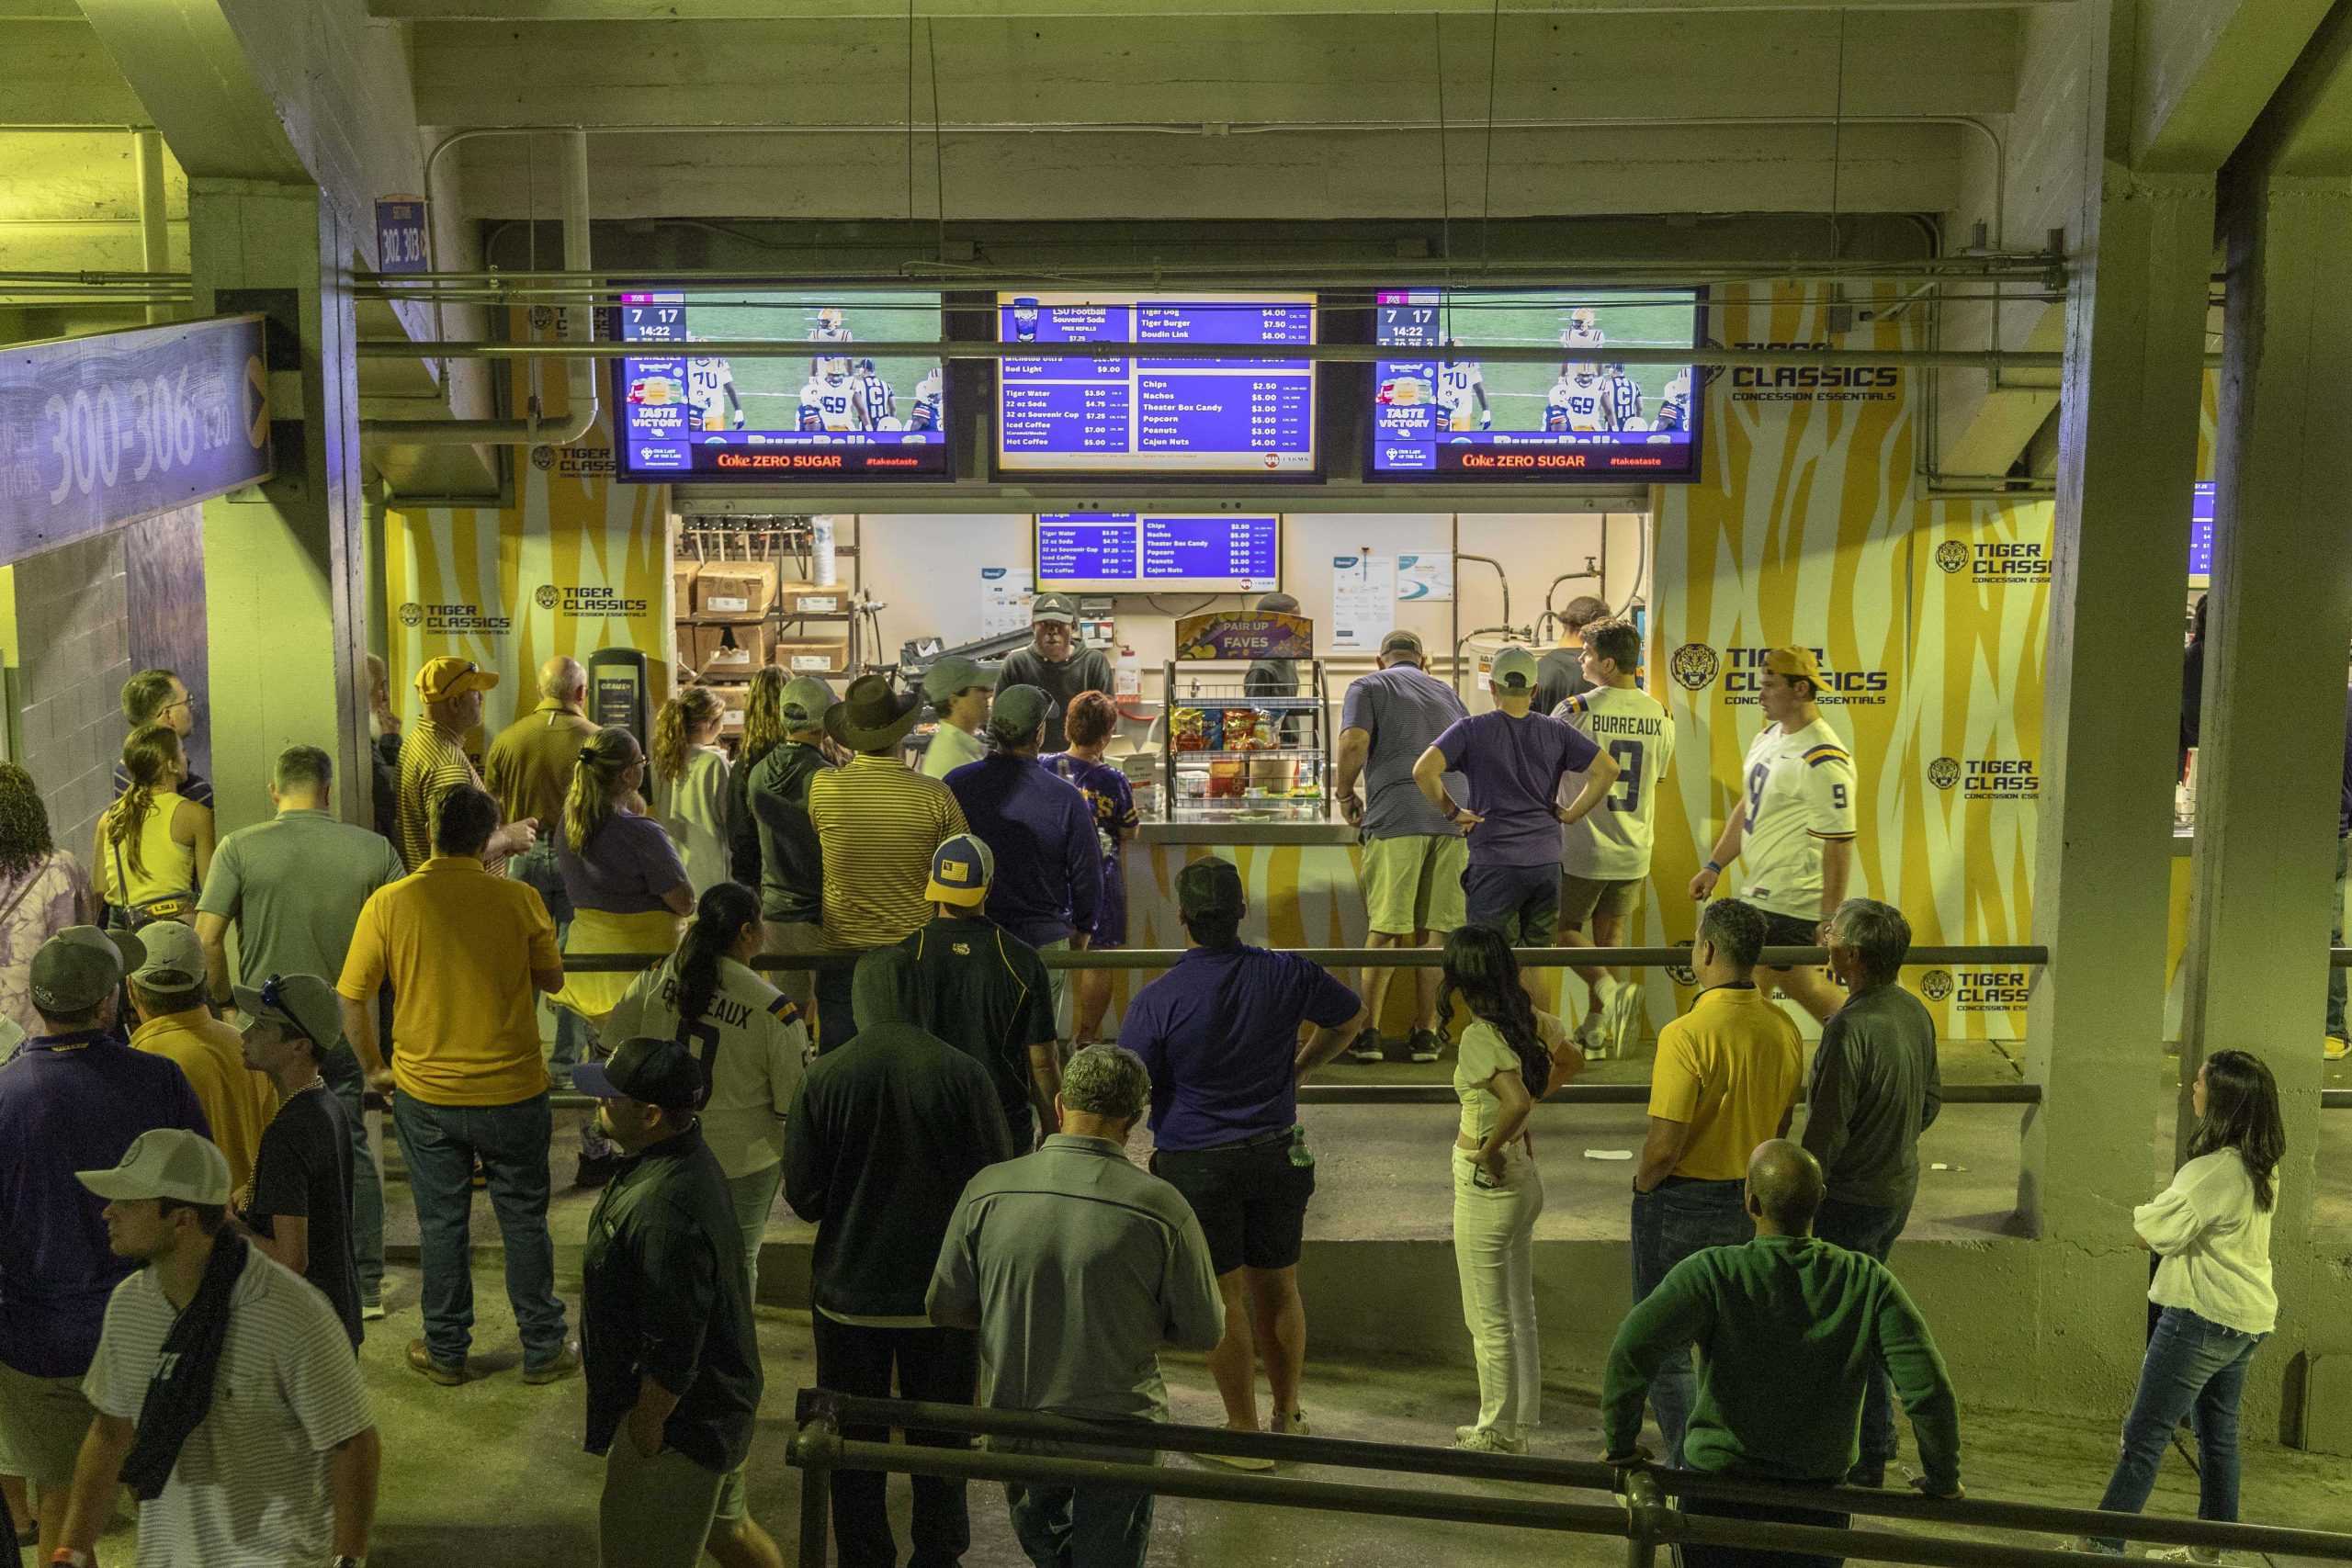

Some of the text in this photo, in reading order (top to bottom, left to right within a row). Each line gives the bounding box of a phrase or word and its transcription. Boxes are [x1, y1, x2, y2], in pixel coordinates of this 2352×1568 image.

[382, 227, 419, 265] 302 303
[632, 309, 678, 323] 7 17
[1143, 309, 1286, 317] Tiger Dog $4.00
[1386, 310, 1431, 323] 7 17
[1163, 320, 1191, 328] Burger
[1263, 321, 1286, 329] $7.50
[639, 326, 671, 336] 14:22
[1393, 327, 1423, 336] 14:22
[1023, 366, 1042, 374] Light
[1733, 367, 1897, 387] CLASSICS
[1143, 380, 1277, 390] Chips $2.50
[1006, 389, 1025, 399] Tiger
[1733, 392, 1895, 400] CONCESSION ESSENTIALS
[825, 396, 846, 413] 69
[1196, 404, 1222, 412] Candy
[1251, 405, 1277, 413] $3.00
[1573, 397, 1594, 414] 69
[638, 408, 678, 419] TASTE
[1386, 408, 1426, 419] TASTE
[632, 419, 683, 427] VICTORY
[1143, 416, 1178, 424] Popcorn
[1379, 419, 1430, 428] VICTORY
[45, 365, 195, 505] 300-306
[560, 448, 610, 459] TIGER
[560, 460, 616, 470] CLASS
[718, 454, 919, 467] Coke ZERO SUGAR #takeataste
[1463, 454, 1661, 467] Coke ZERO SUGAR #takeataste
[1973, 544, 2041, 557] TIGER
[1973, 560, 2052, 574] CLASSI
[563, 588, 614, 597] TIGER
[426, 604, 477, 615] TIGER
[562, 599, 647, 610] CLASSICS
[426, 617, 511, 628] CLASSICS
[1224, 622, 1269, 630] PAIR UP
[1224, 637, 1269, 648] FAVES
[1726, 649, 1824, 667] TIR
[1725, 672, 1888, 691] CLICS
[1815, 696, 1886, 705] SSENTIALS
[1593, 715, 1662, 736] BURREAUX
[1966, 761, 2032, 773] TIGER
[1607, 739, 1644, 812] 9
[1964, 776, 2039, 790] CLASS
[1744, 762, 1770, 835] 9
[1832, 784, 1847, 809] 9
[154, 903, 175, 912] LSU
[1958, 973, 2024, 987] TIGER
[1957, 988, 2029, 1002] CLASS
[662, 977, 753, 1030] BEAUX
